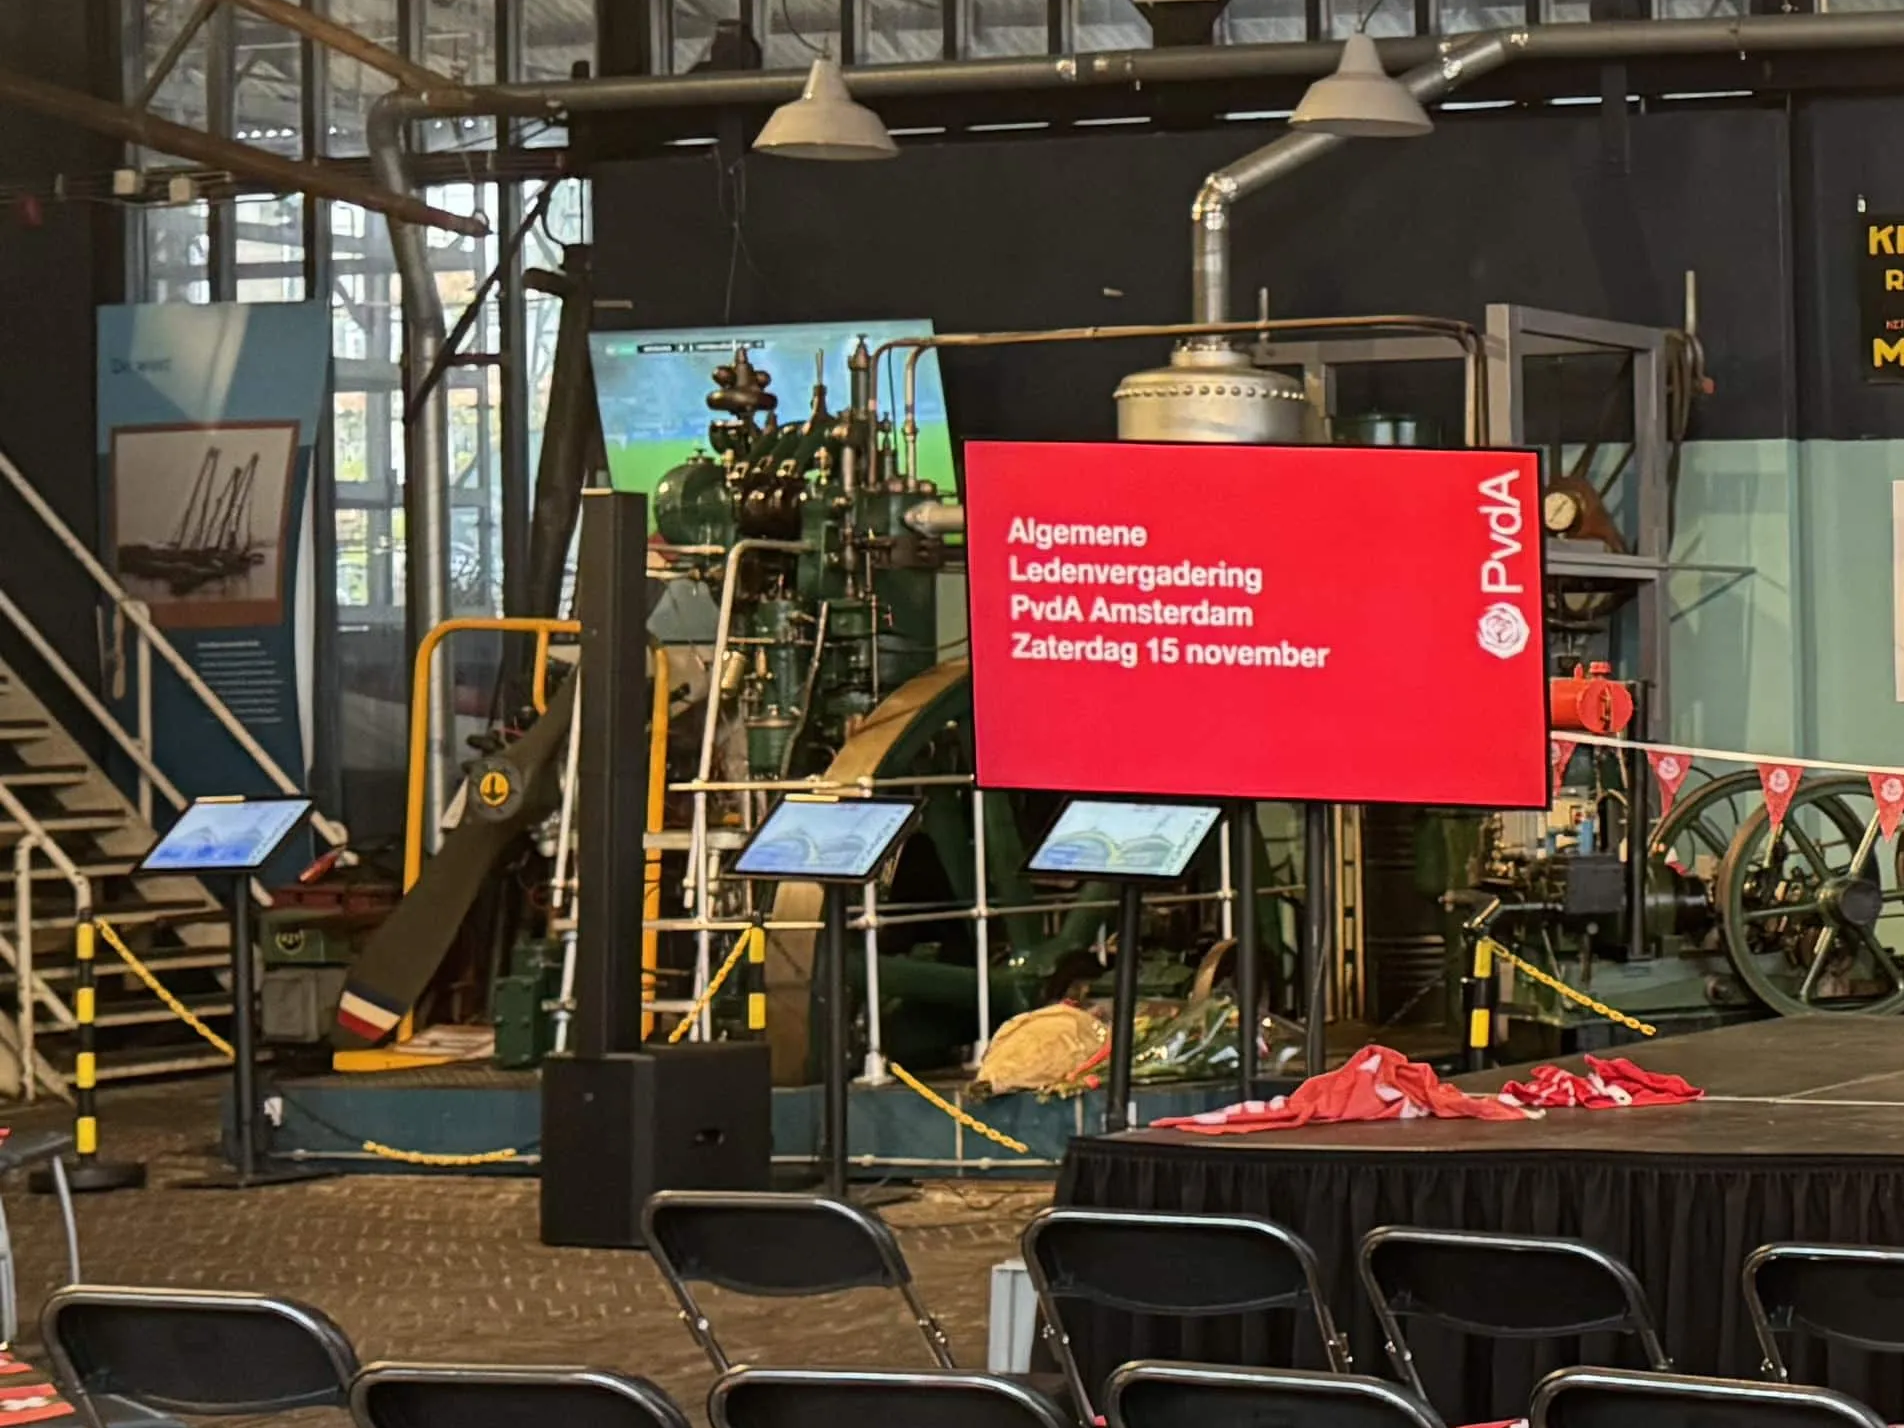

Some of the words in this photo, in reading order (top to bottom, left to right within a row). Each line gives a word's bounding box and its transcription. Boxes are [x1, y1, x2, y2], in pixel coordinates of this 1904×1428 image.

[1008, 517, 1148, 550] Algemene
[1477, 469, 1524, 593] PvdA
[1009, 555, 1263, 595] Ledenvergadering
[1011, 594, 1084, 622] PvdA
[1090, 596, 1254, 627] Amsterdam
[1011, 632, 1139, 668] Zaterdag
[1146, 637, 1180, 664] 15
[1186, 641, 1331, 668] november
